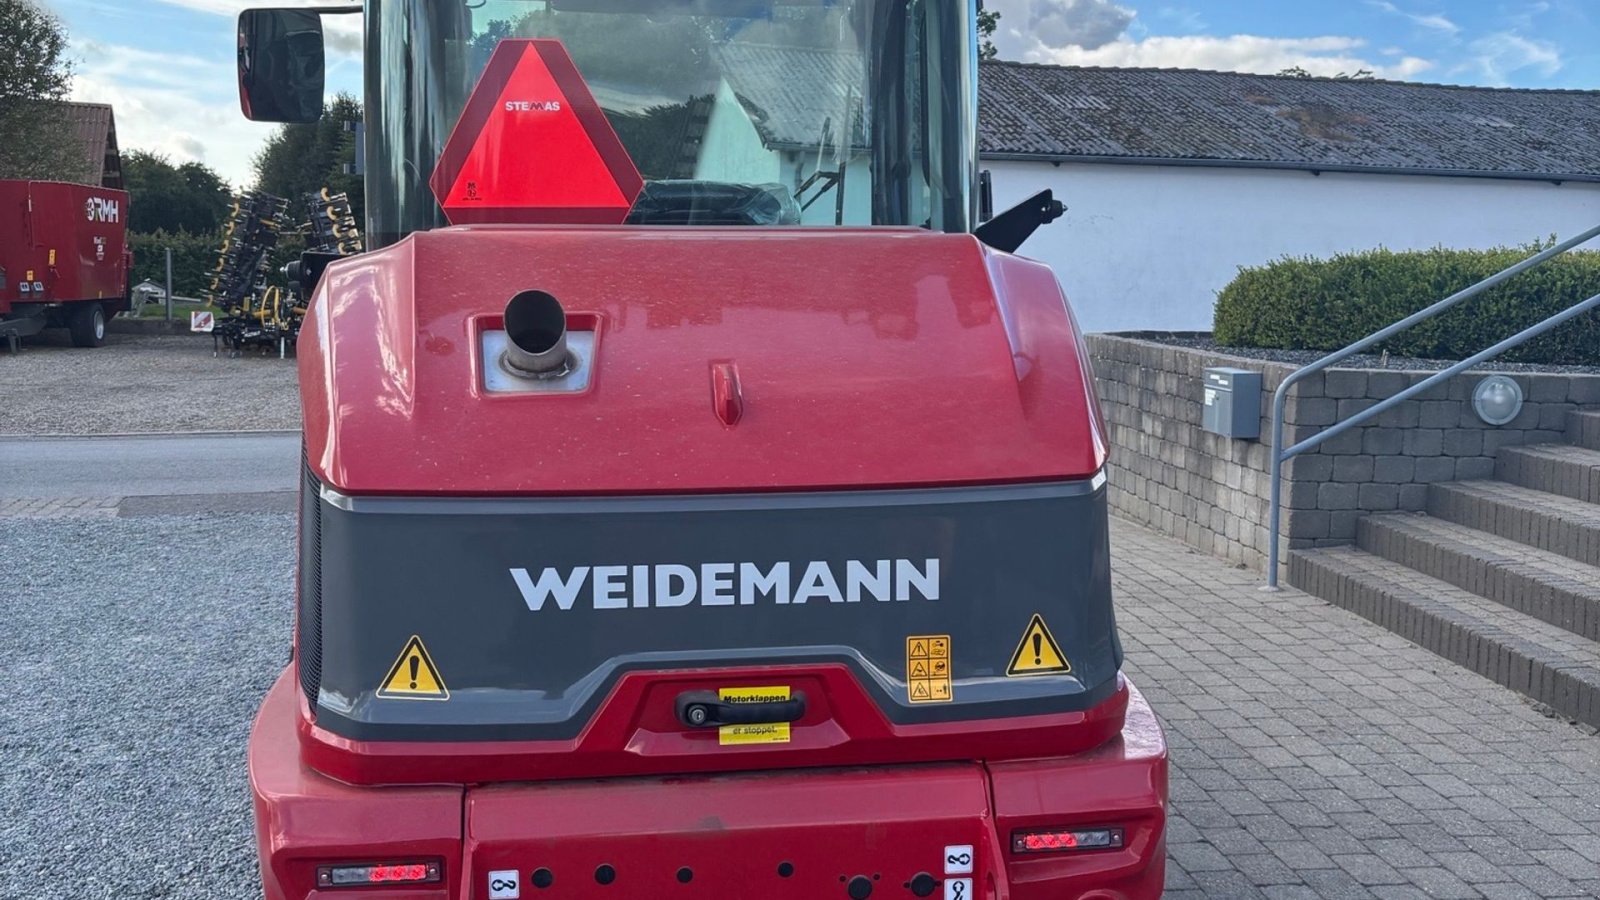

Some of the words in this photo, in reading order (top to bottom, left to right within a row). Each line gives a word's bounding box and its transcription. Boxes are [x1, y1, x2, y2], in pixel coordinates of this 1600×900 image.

[505, 101, 561, 111] STEMAS
[93, 197, 119, 223] RMH
[509, 558, 940, 612] WEIDEMANN
[723, 694, 786, 704] Motorklappen
